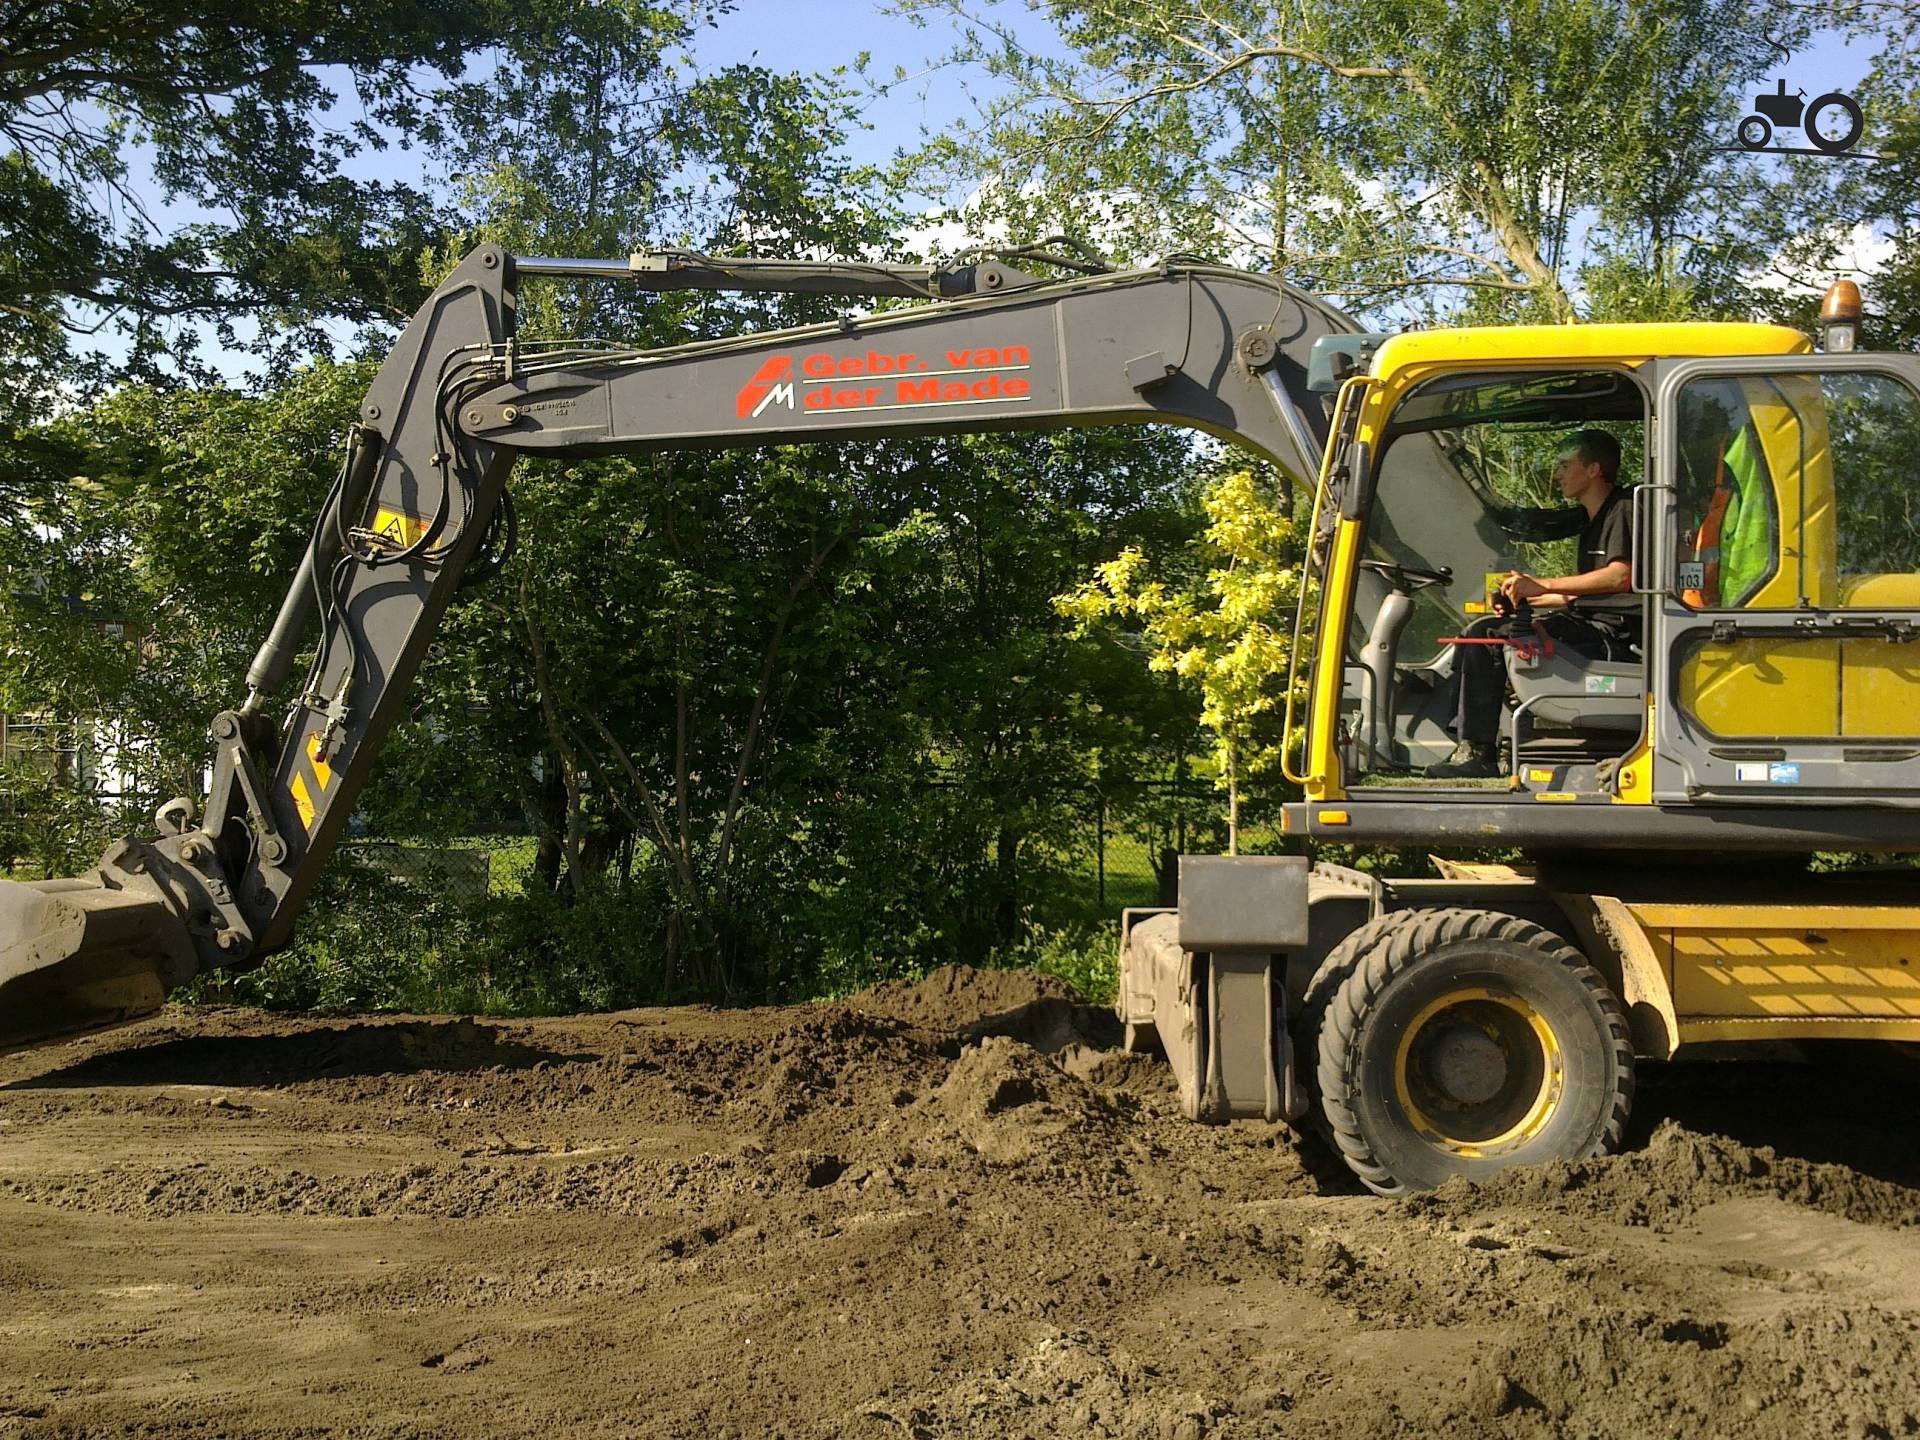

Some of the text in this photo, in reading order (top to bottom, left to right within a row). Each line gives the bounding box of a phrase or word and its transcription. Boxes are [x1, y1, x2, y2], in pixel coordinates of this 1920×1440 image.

[803, 345, 1030, 377] Gebr. van
[804, 375, 1030, 409] der Made
[1679, 574, 1699, 588] 103
